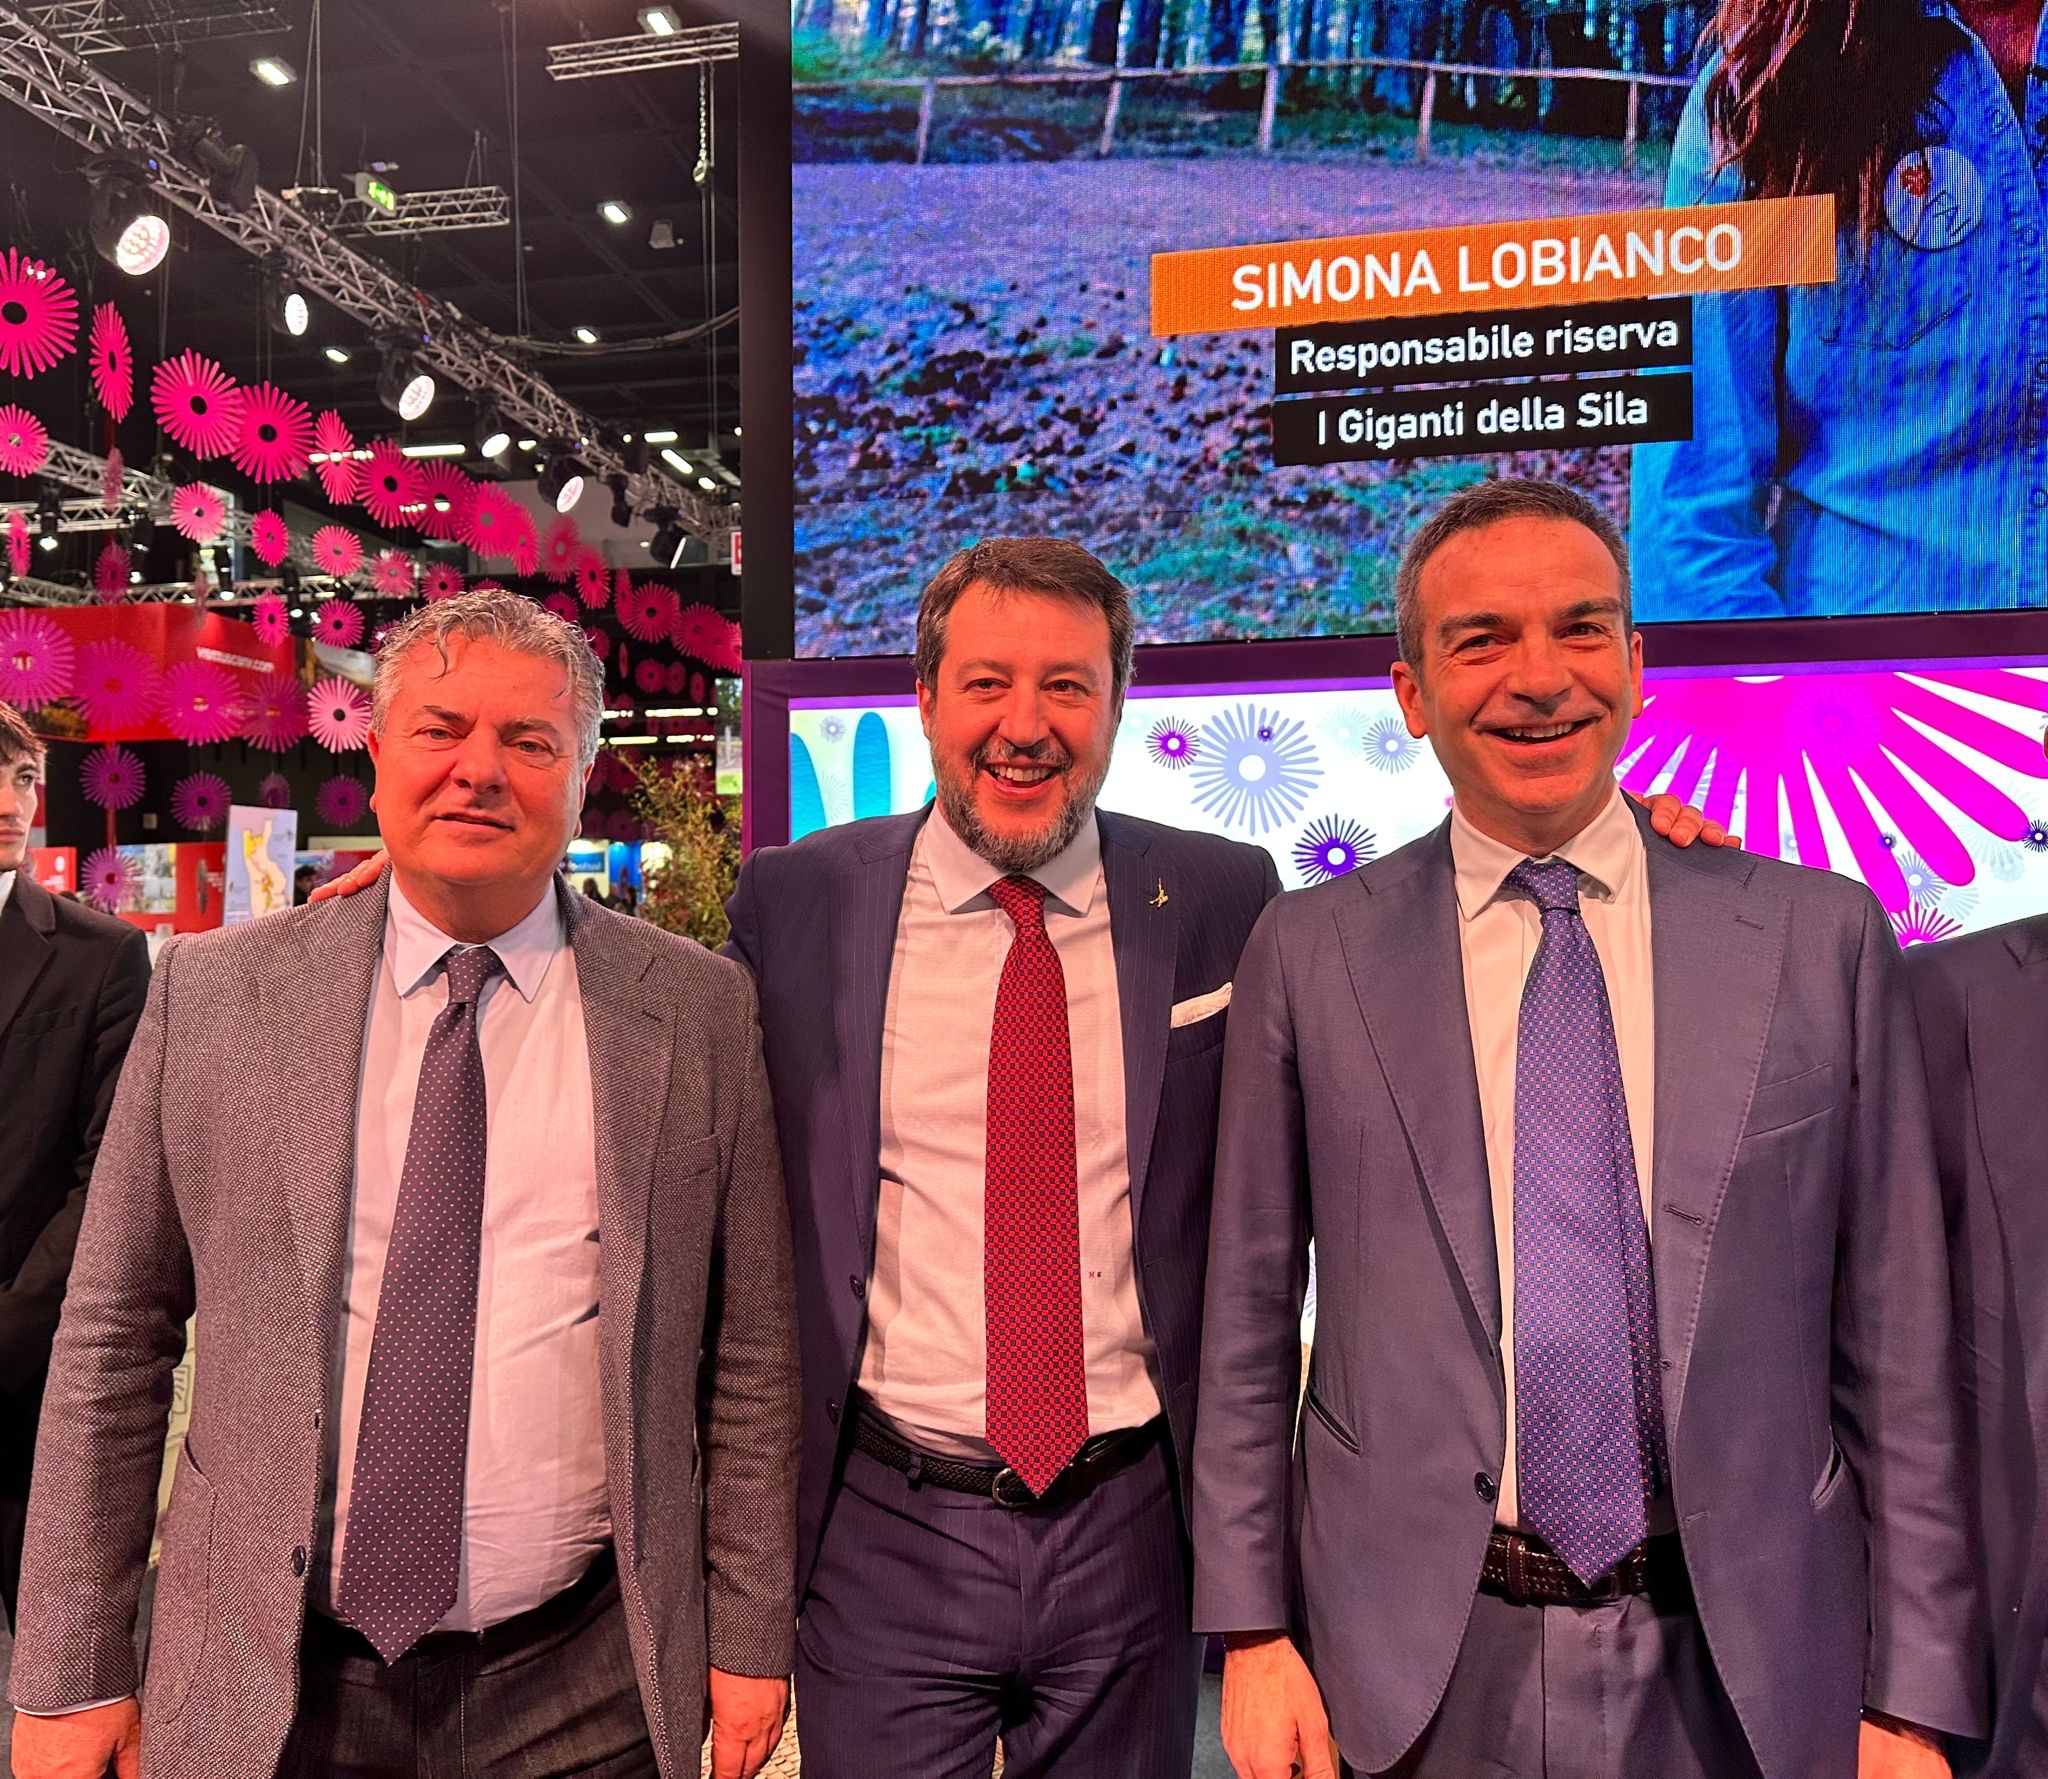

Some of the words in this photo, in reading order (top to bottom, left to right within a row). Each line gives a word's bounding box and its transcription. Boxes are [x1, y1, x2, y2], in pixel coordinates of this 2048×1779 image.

[1231, 248, 1442, 311] SIMONA
[1458, 224, 1744, 292] LOBIANCO
[1290, 328, 1535, 376] Responsabile
[1545, 316, 1679, 356] riserva
[1318, 410, 1326, 446] I
[1338, 401, 1464, 452] Giganti
[1476, 393, 1566, 437] della
[1577, 391, 1648, 429] Sila
